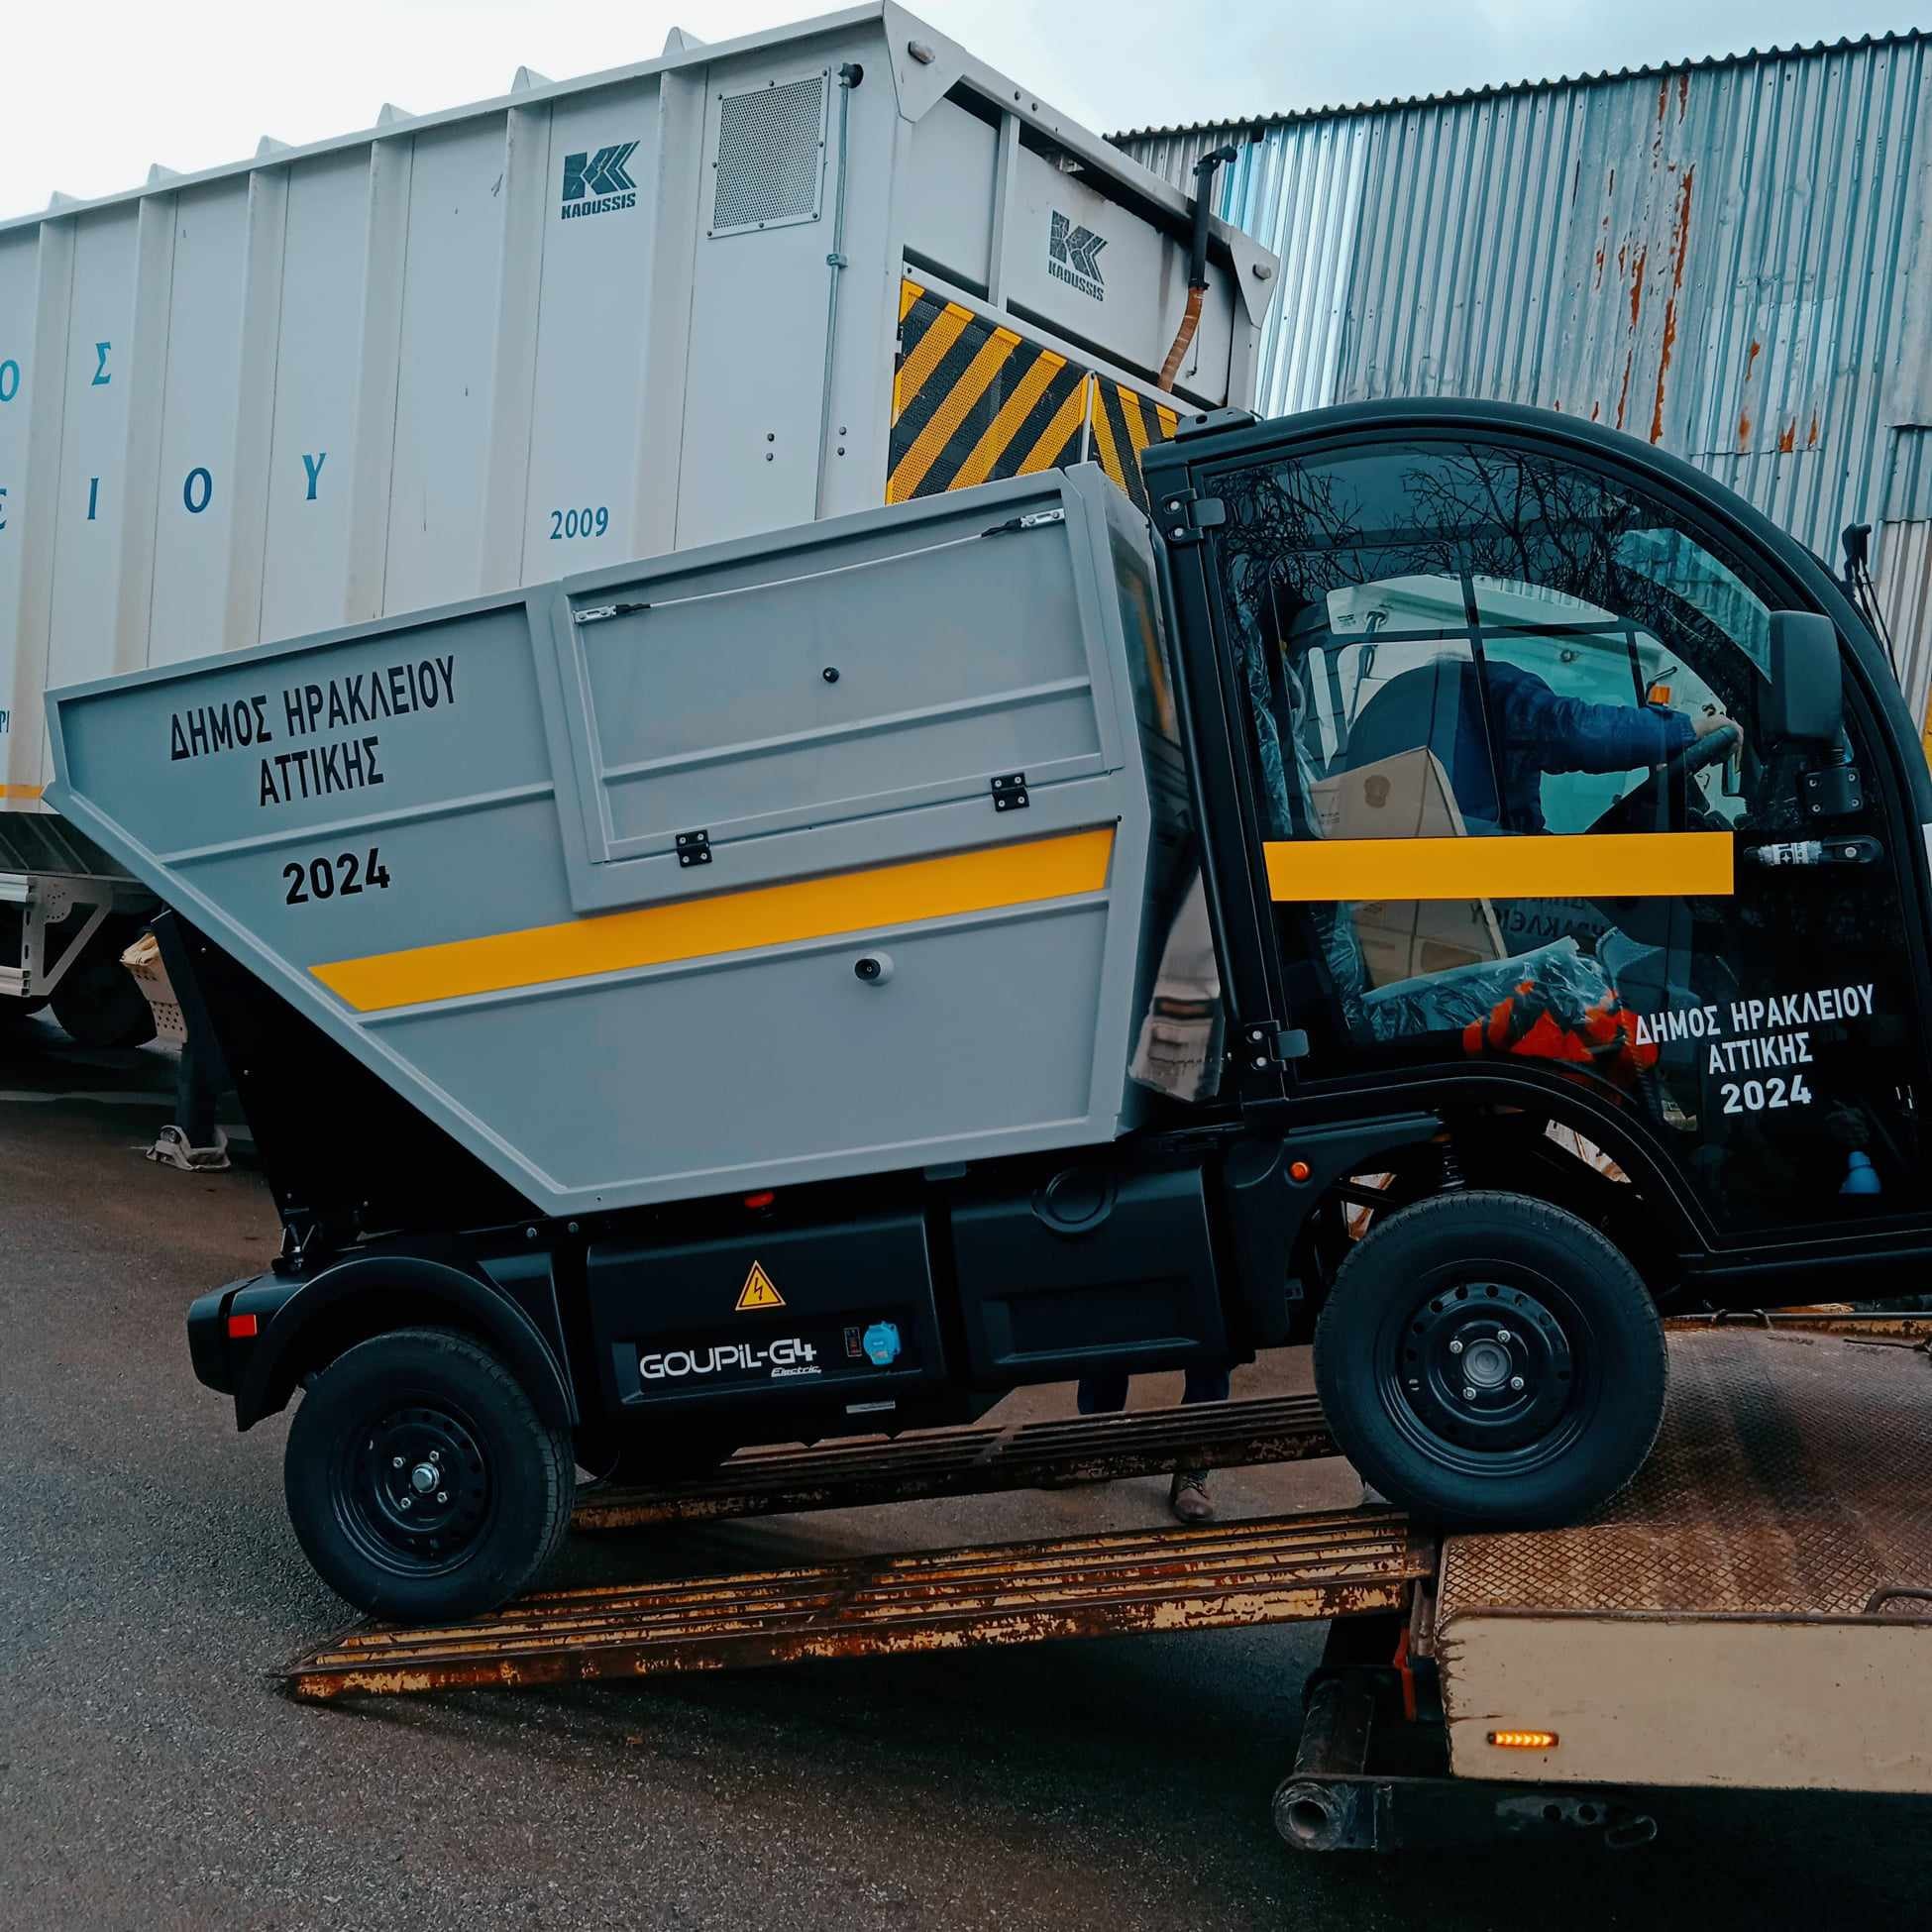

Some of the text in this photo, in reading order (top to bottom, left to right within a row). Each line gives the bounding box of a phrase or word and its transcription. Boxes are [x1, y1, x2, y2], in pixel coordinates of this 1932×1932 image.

[561, 192, 637, 220] KAOUSSIS
[1048, 260, 1105, 302] KAOUSSIS
[550, 506, 609, 540] 2009
[170, 655, 456, 761] ΔΗΜΟΣ ΗΡΑΚΛΕΙΟΥ
[260, 735, 384, 807] ΑΤΤΙΚΗΣ
[282, 847, 391, 906] 2024
[1635, 984, 1875, 1046] ΔΗΜΟΣ ΗΡΑΚΛΕΙΟΥ
[1708, 1031, 1814, 1075] ΑΤΤΙΚΗΣ
[1720, 1074, 1813, 1116] 2024
[771, 1365, 821, 1378] Electric
